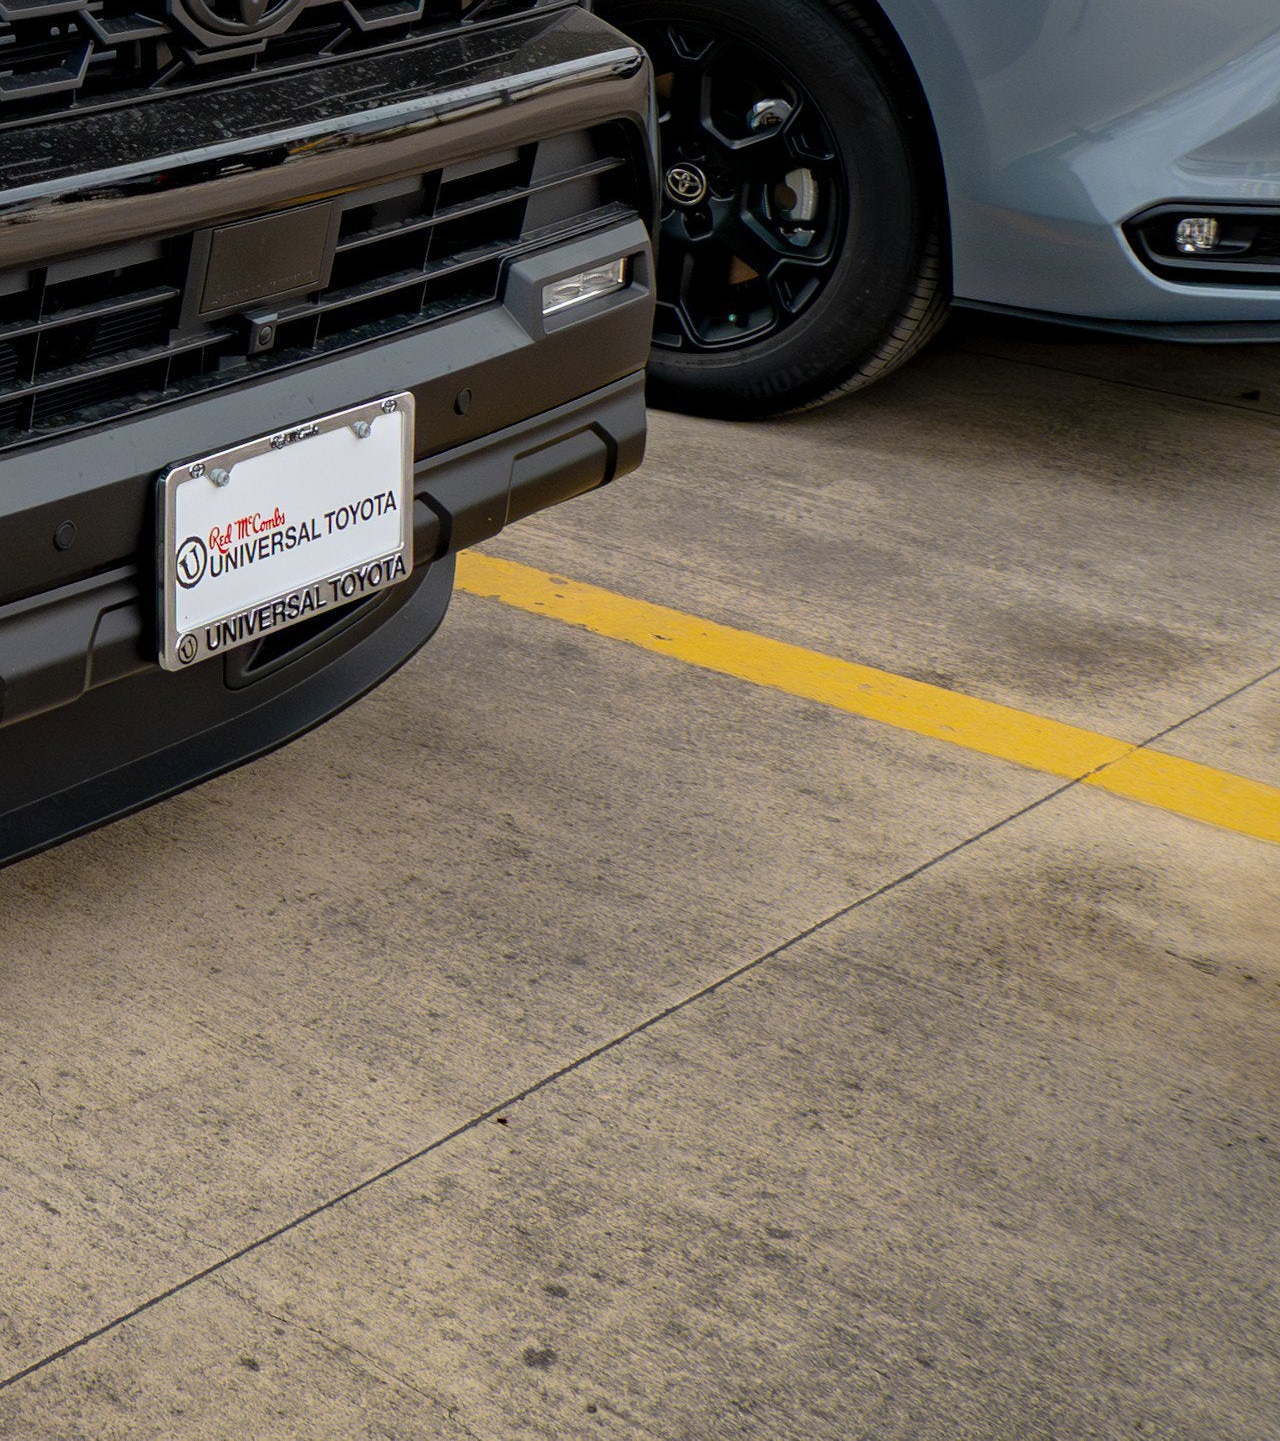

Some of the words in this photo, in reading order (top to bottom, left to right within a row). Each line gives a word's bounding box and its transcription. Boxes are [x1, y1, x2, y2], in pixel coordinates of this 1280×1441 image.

[208, 522, 233, 554] Red
[209, 518, 322, 578] UNIVERSAL
[323, 490, 397, 535] TOYOTA
[205, 585, 327, 651] UNIVERSAL
[328, 553, 407, 603] TOYOTA
